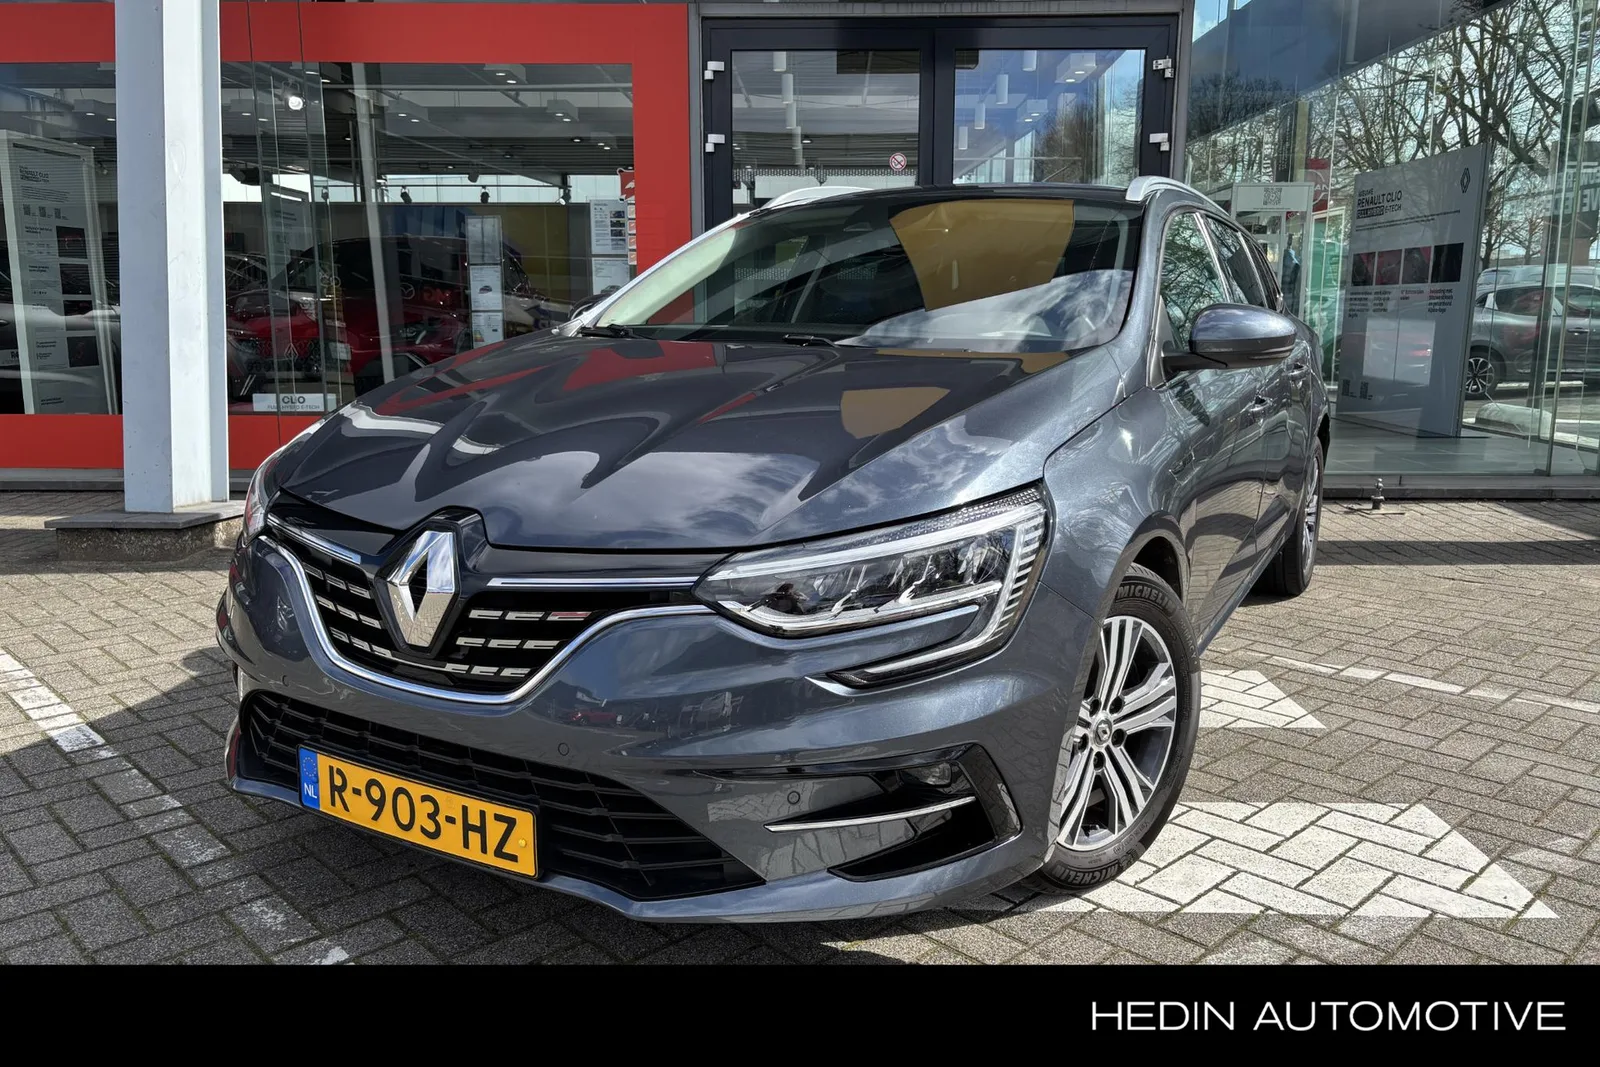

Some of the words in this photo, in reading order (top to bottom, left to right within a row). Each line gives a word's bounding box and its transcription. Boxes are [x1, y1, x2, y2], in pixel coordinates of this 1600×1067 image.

[1357, 195, 1386, 208] RENAULT
[1386, 190, 1403, 202] CLIO
[1117, 585, 1176, 616] MICHELIN
[303, 782, 318, 799] NL
[328, 764, 519, 863] R-903-HZ
[1052, 862, 1119, 885] MICHELIN
